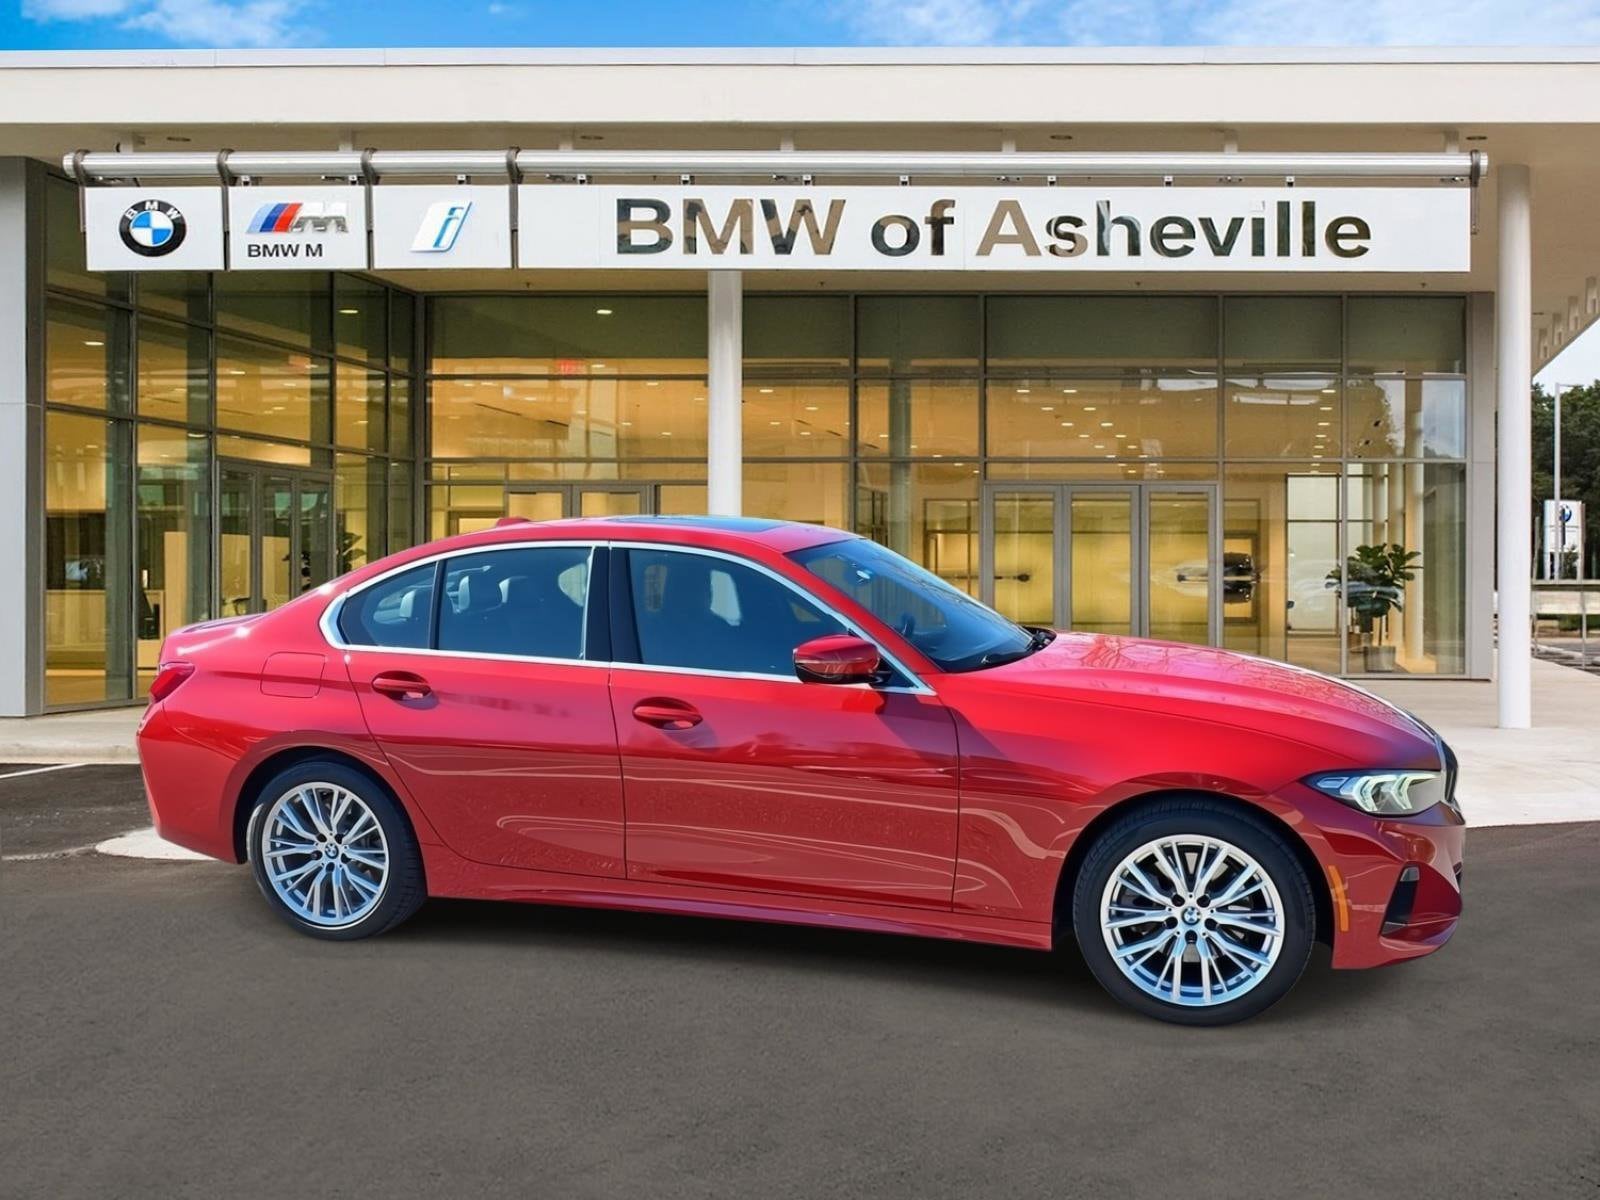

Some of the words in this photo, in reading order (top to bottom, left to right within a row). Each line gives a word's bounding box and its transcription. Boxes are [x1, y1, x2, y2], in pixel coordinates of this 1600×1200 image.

[125, 201, 181, 220] BMW
[616, 198, 846, 255] BMW
[871, 199, 956, 257] of
[975, 199, 1372, 258] Asheville
[247, 243, 300, 257] BMW
[305, 243, 323, 257] M
